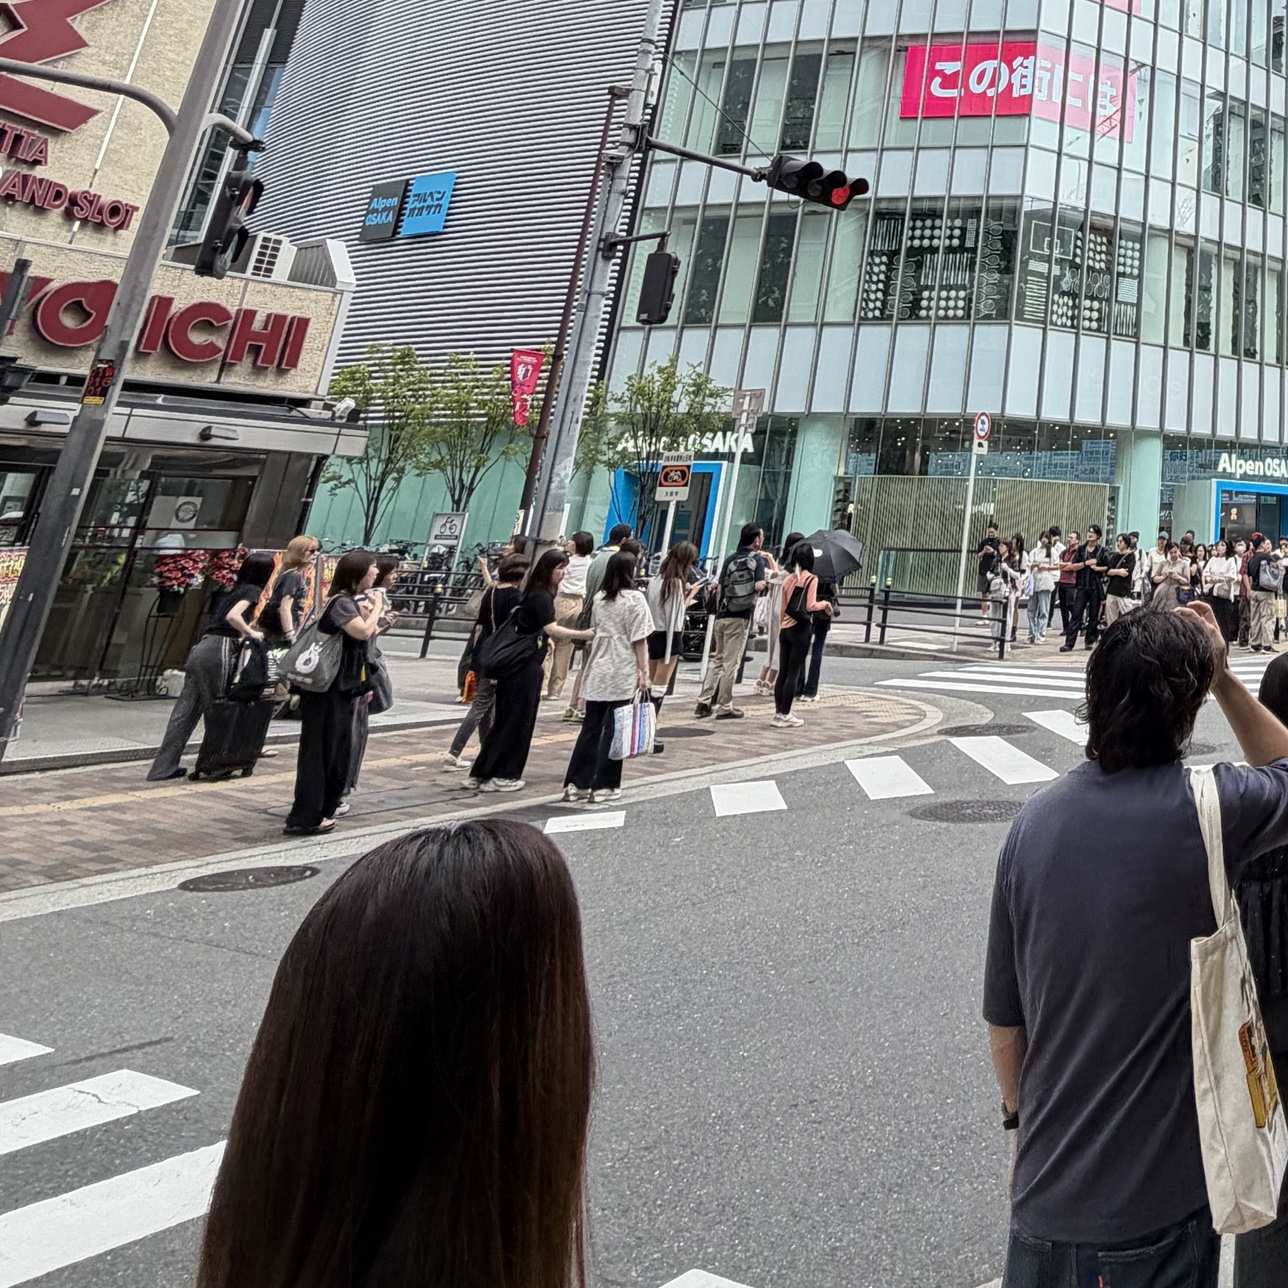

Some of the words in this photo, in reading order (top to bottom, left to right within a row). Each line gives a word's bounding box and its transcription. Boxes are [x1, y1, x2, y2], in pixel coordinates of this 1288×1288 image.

[930, 55, 1117, 117] この街には
[0, 171, 69, 210] AND
[73, 190, 140, 231] SLOT
[365, 210, 393, 226] OSAKA
[369, 196, 399, 211] Alpen
